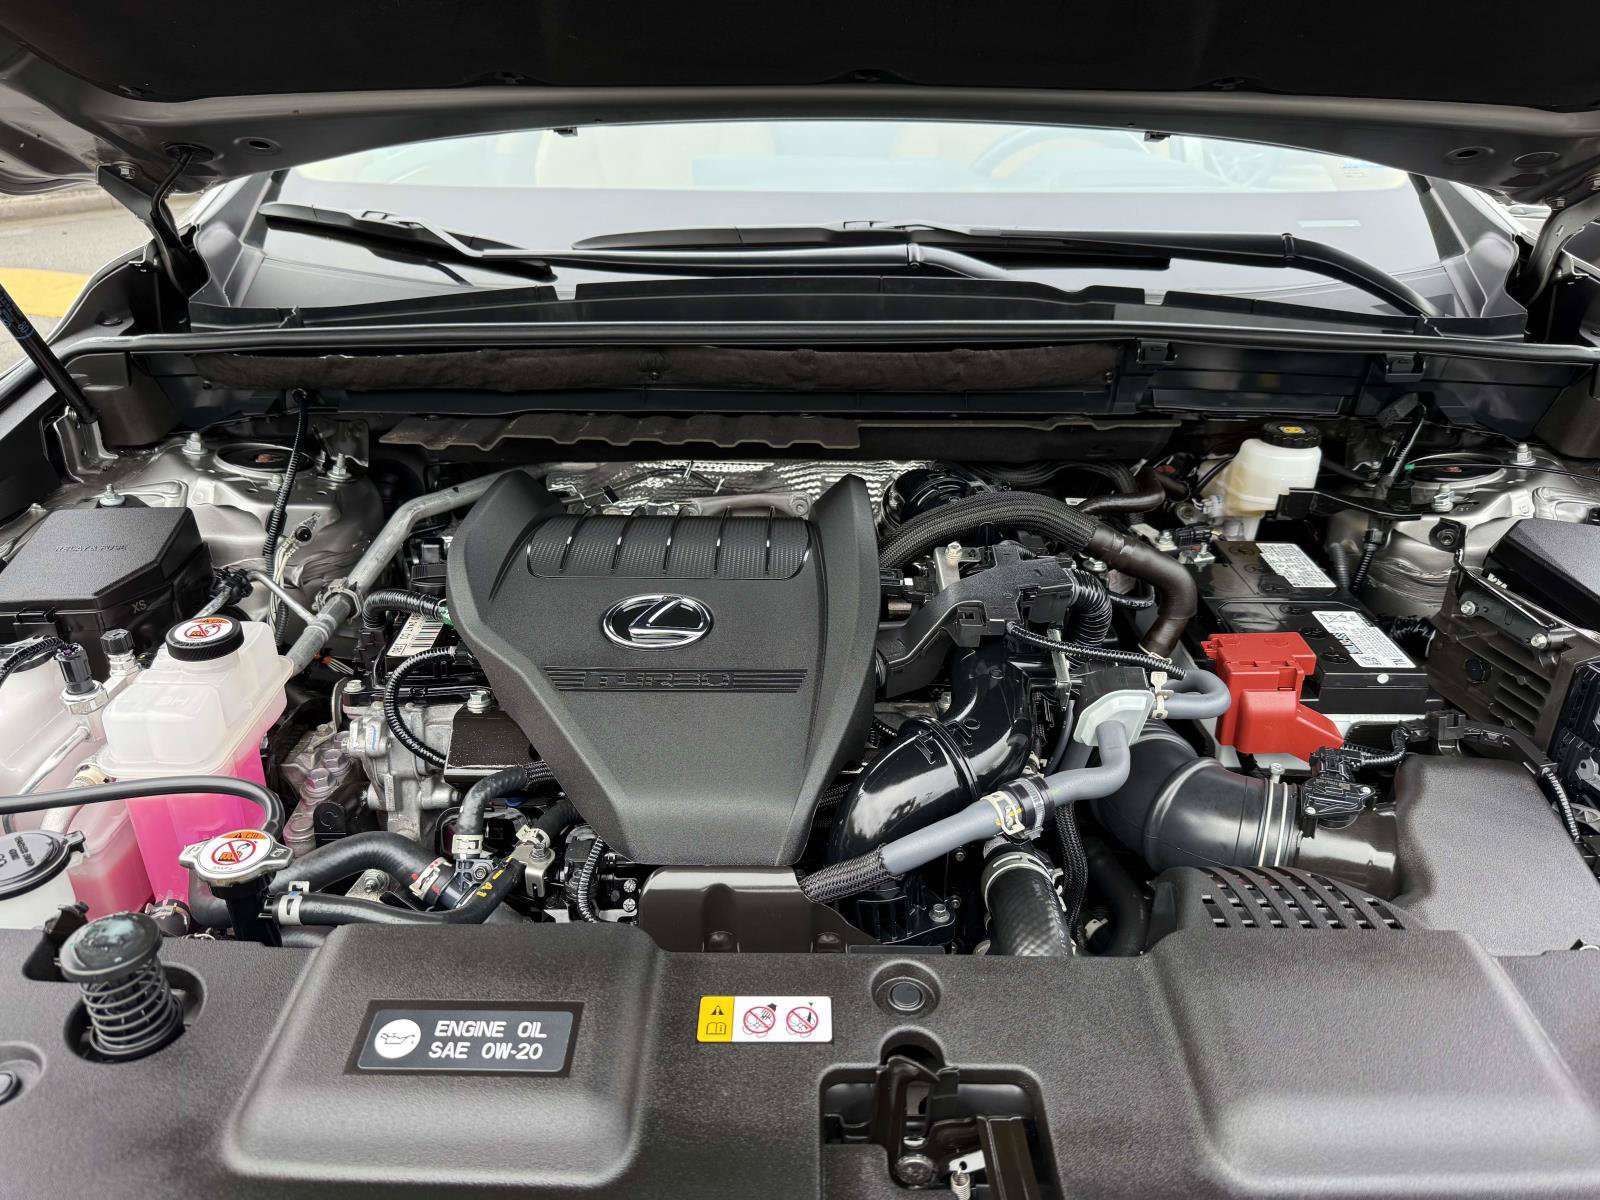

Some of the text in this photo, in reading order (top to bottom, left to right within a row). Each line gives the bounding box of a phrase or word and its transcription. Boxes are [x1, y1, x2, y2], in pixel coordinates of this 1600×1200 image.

[585, 671, 734, 688] TURBO
[433, 1020, 548, 1038] ENGINE OIL
[428, 1041, 543, 1060] SAE 0W-20
